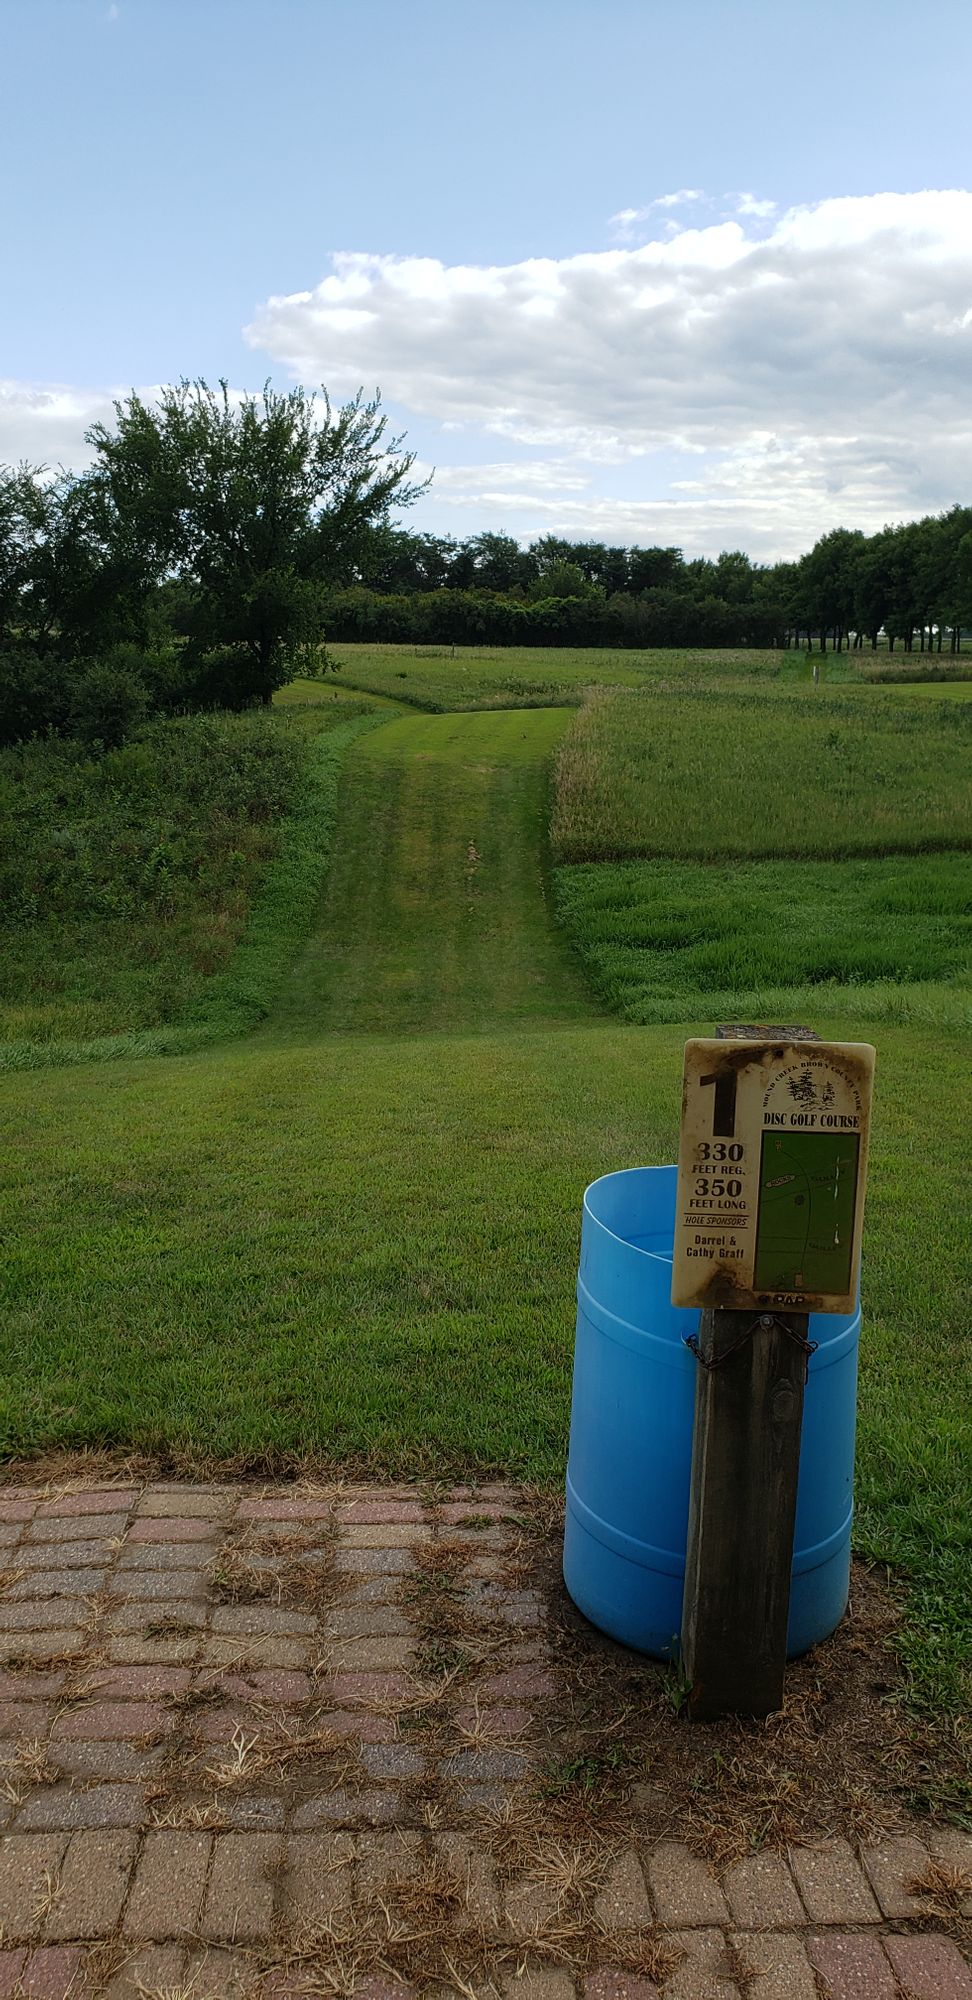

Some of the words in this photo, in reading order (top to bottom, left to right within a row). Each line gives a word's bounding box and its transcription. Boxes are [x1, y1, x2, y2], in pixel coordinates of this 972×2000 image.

[775, 1066, 798, 1081] CREEK
[700, 1069, 737, 1137] 1
[764, 1113, 787, 1125] DISC
[791, 1113, 817, 1126] GOLF
[820, 1115, 859, 1128] COURSE
[697, 1143, 744, 1161] 330
[692, 1165, 717, 1174] FEET
[695, 1178, 742, 1197] 350
[689, 1199, 715, 1208] FEET
[718, 1201, 746, 1209] LONG
[685, 1216, 704, 1224] HOLE
[706, 1217, 747, 1225] SPONSORS
[695, 1235, 725, 1245] Darrel
[730, 1236, 736, 1245] &
[687, 1247, 714, 1258] Cathy
[719, 1249, 743, 1258] Graff
